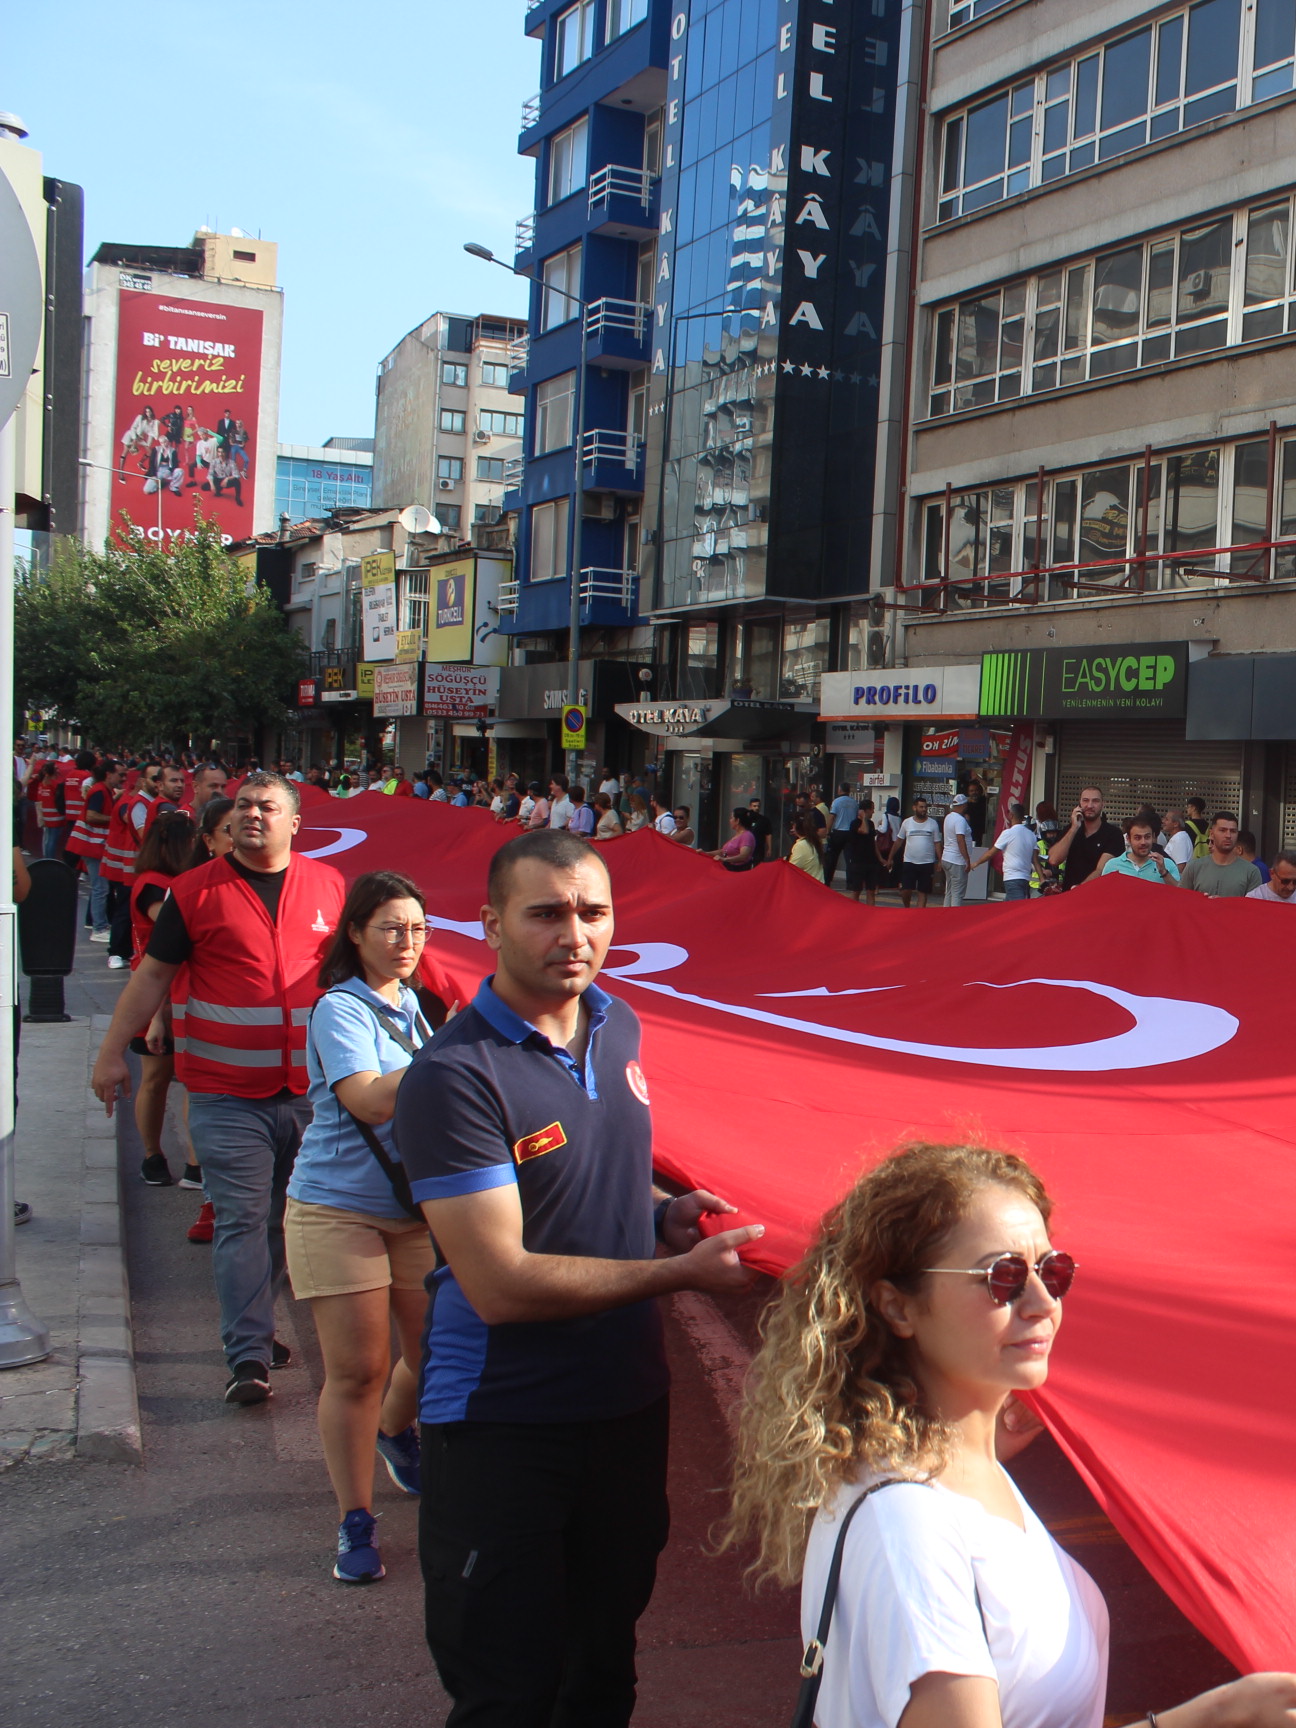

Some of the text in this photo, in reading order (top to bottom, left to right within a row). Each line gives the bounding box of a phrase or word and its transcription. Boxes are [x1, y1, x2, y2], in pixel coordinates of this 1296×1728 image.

[666, 12, 686, 169] OTEL
[788, 144, 832, 332] KÂYA
[151, 354, 225, 373] severiz
[132, 371, 245, 395] birbirimizi
[442, 665, 471, 674] MEŞHUR
[1062, 655, 1175, 692] EASYCEP
[428, 672, 487, 687] SÖĞÜŞÇÜ
[427, 685, 487, 696] HÜSEYİN
[439, 695, 475, 703] USTA
[544, 688, 588, 709] SAMSG
[1062, 696, 1163, 708] YENİLENMENİN YENİ KOLAYI
[630, 709, 662, 724] OTEL
[922, 761, 953, 773] Fibabanka
[869, 774, 885, 785] airfel
